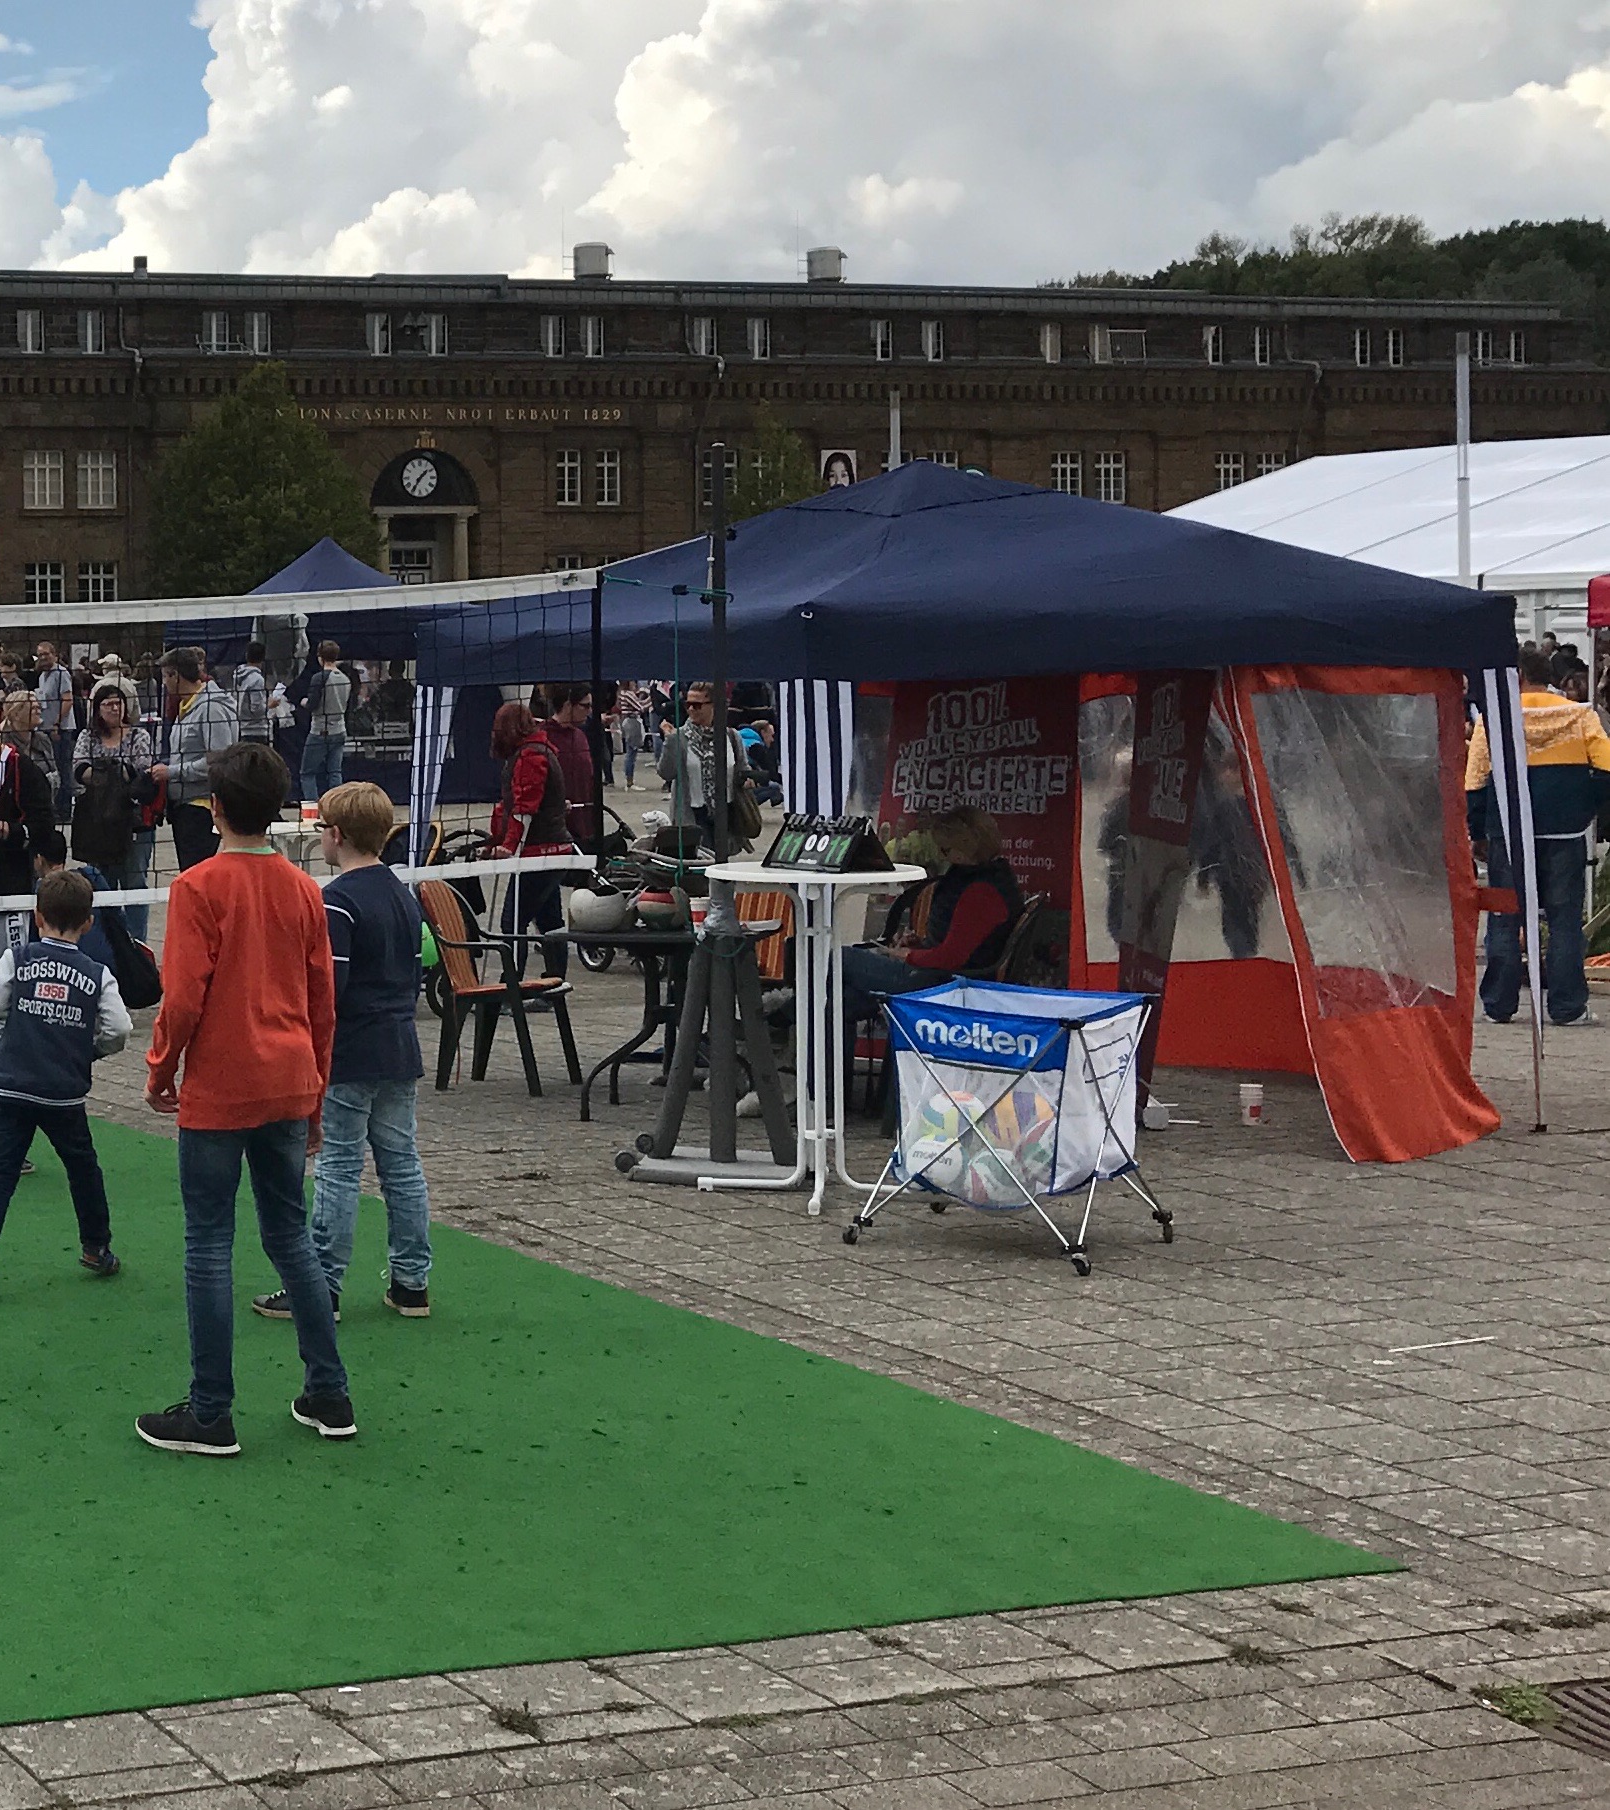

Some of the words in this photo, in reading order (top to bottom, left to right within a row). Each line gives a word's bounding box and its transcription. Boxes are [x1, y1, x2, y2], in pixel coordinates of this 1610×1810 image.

[505, 408, 571, 420] ERBAUT
[584, 408, 622, 420] 1829
[899, 718, 1040, 759] VOLLEYBALL
[893, 756, 1068, 796] ENGAGIERTE
[777, 833, 806, 861] 11
[823, 835, 852, 865] 11
[16, 961, 97, 996] CROSSWIND
[55, 1003, 82, 1021] CLUB
[915, 1018, 1039, 1058] molten
